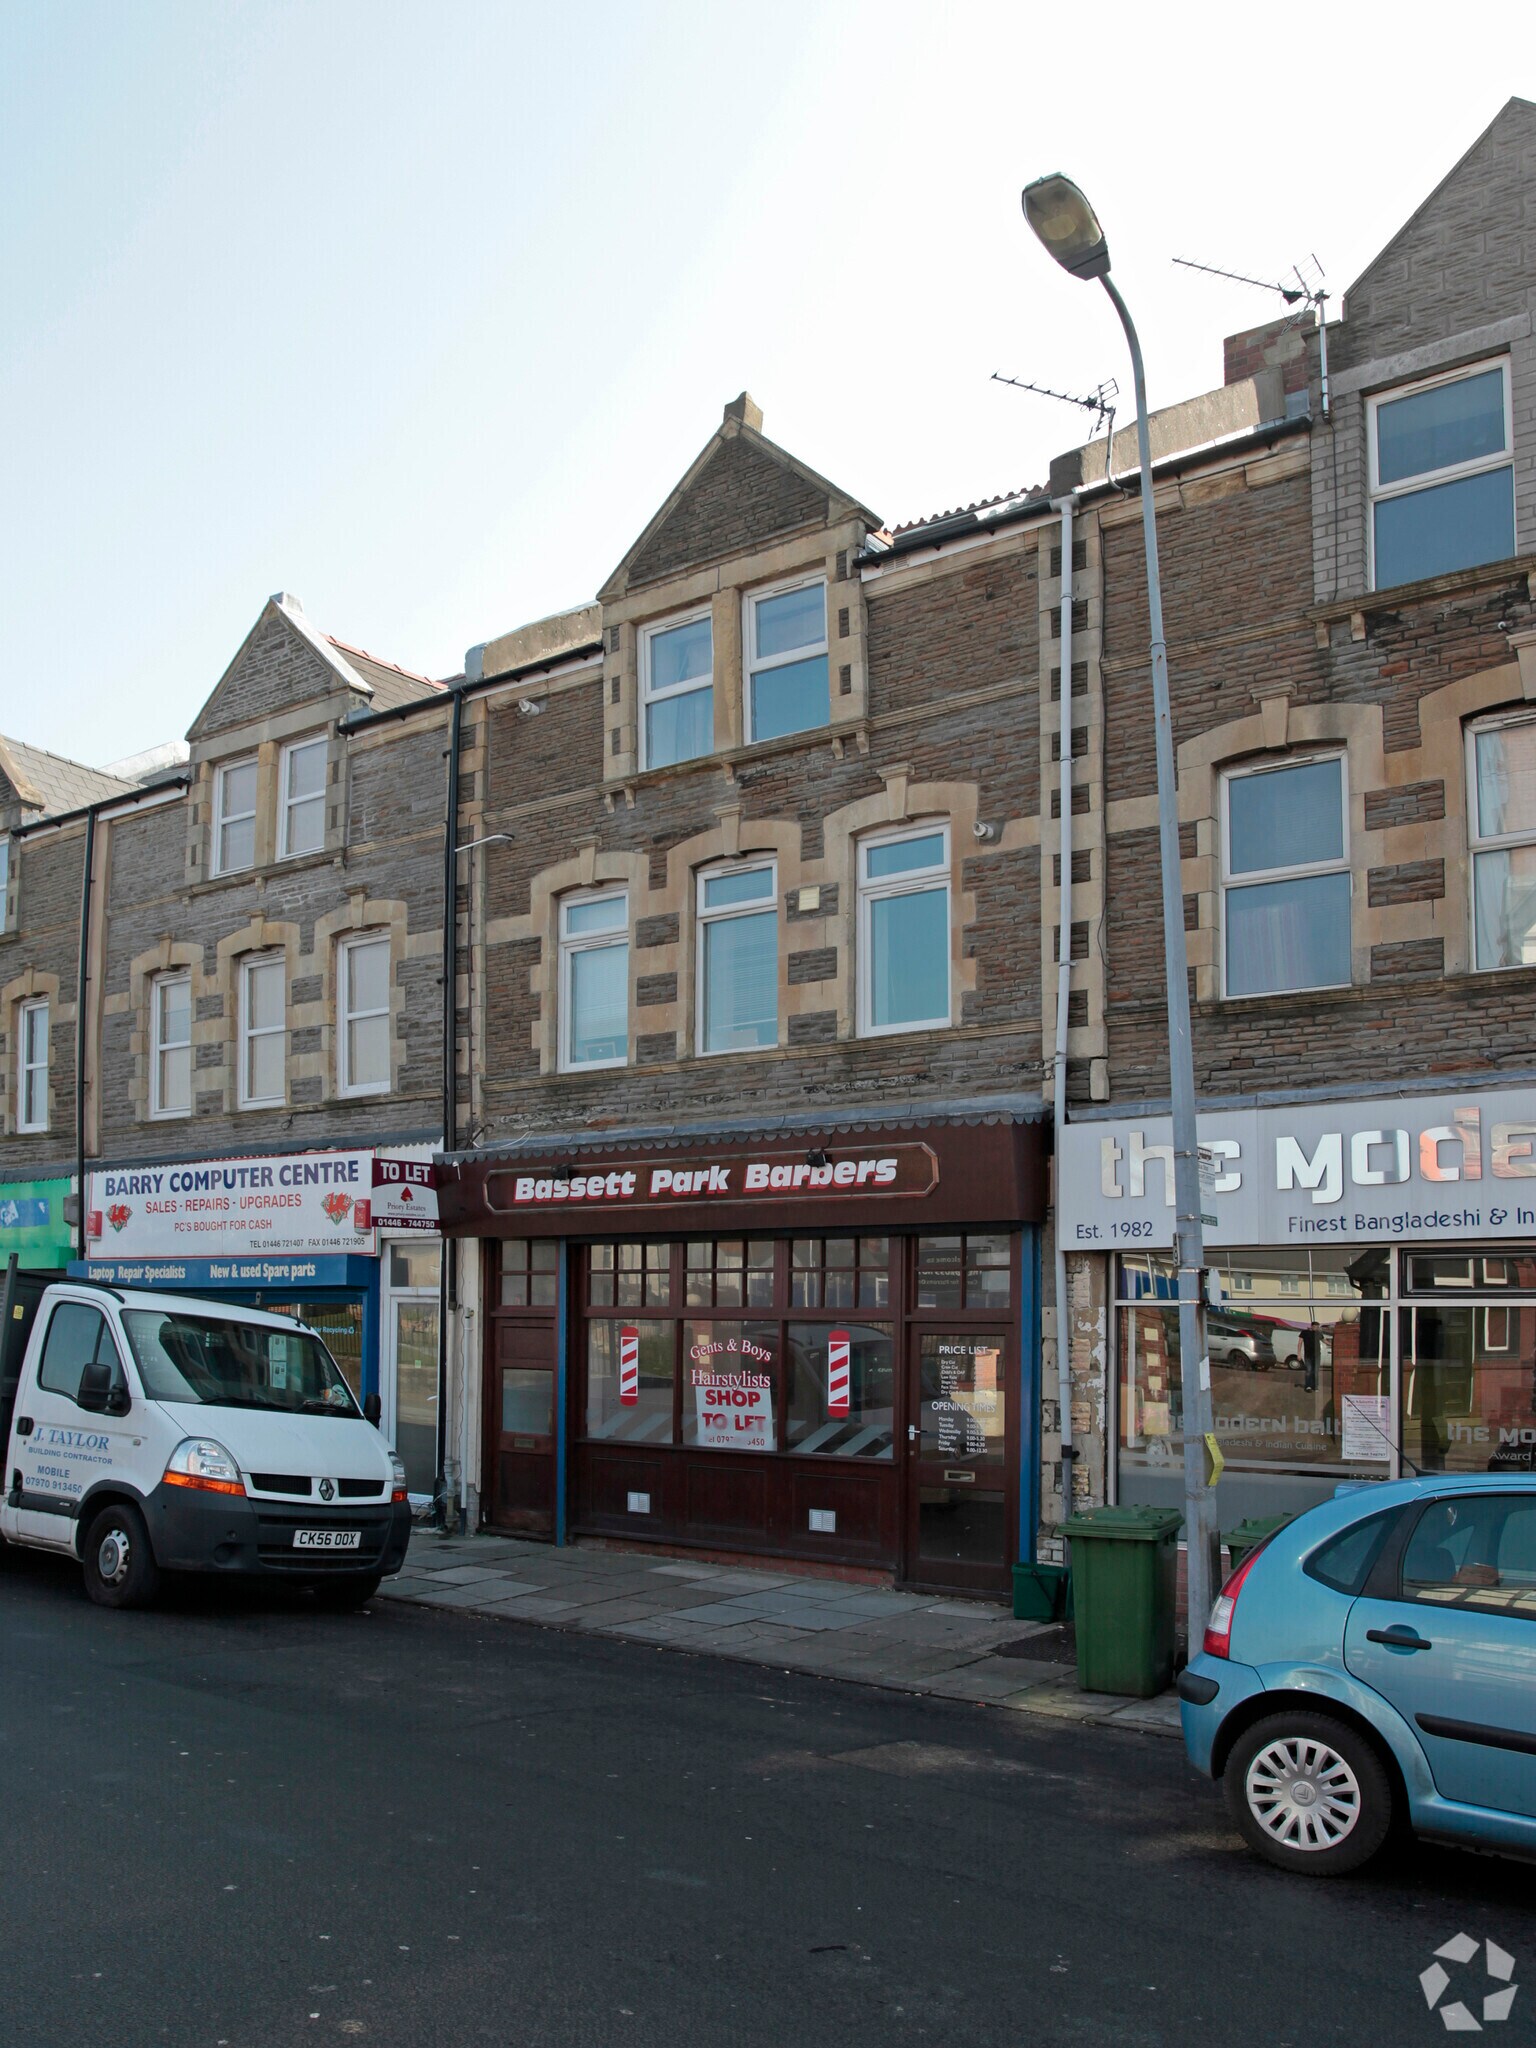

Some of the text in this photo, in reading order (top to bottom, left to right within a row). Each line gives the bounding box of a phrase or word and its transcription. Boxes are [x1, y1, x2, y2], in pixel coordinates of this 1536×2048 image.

[380, 1162, 430, 1182] TO LET
[1101, 1131, 1241, 1206] the
[105, 1160, 359, 1196] BARRY COMPUTER CENTRE
[514, 1159, 898, 1201] Bassett Park Barbers
[145, 1200, 177, 1214] SALES
[185, 1198, 230, 1211] REPAIRS
[240, 1194, 302, 1209] UPGRADES
[174, 1219, 272, 1232] PC'S BOUGHT FOR CASH
[1289, 1215, 1347, 1233] Finest
[1355, 1209, 1480, 1233] Bangladeshi
[1489, 1208, 1508, 1226] &
[1076, 1221, 1153, 1239] Est. 1982
[250, 1240, 262, 1248] TEL
[262, 1240, 281, 1248] 01446
[308, 1238, 320, 1246] FAX
[321, 1238, 340, 1246] 01446
[88, 1265, 186, 1282] Laptop Repair Specialists
[210, 1262, 316, 1282] New & used Spare parts
[322, 1326, 348, 1335] Recycling
[690, 1338, 773, 1361] Gents & Boys
[938, 1345, 988, 1355] PRICE LIST
[691, 1369, 771, 1391] Hairstylists
[705, 1389, 761, 1407] SHOP
[931, 1401, 996, 1412] OPENING TIMES
[702, 1412, 766, 1433] TO LET
[1215, 1414, 1287, 1433] odern
[33, 1427, 109, 1451] J. TAYLOR
[1447, 1423, 1490, 1445] the
[1217, 1438, 1253, 1447] gladeshi
[1265, 1440, 1293, 1449] Indian
[1295, 1441, 1327, 1451] Cuisine
[28, 1447, 113, 1465] BUILDING CONTRACTOR
[1489, 1451, 1532, 1461] Award
[37, 1465, 70, 1479] MOBILE
[25, 1476, 83, 1494] 07970 913450
[299, 1532, 332, 1545] CK56
